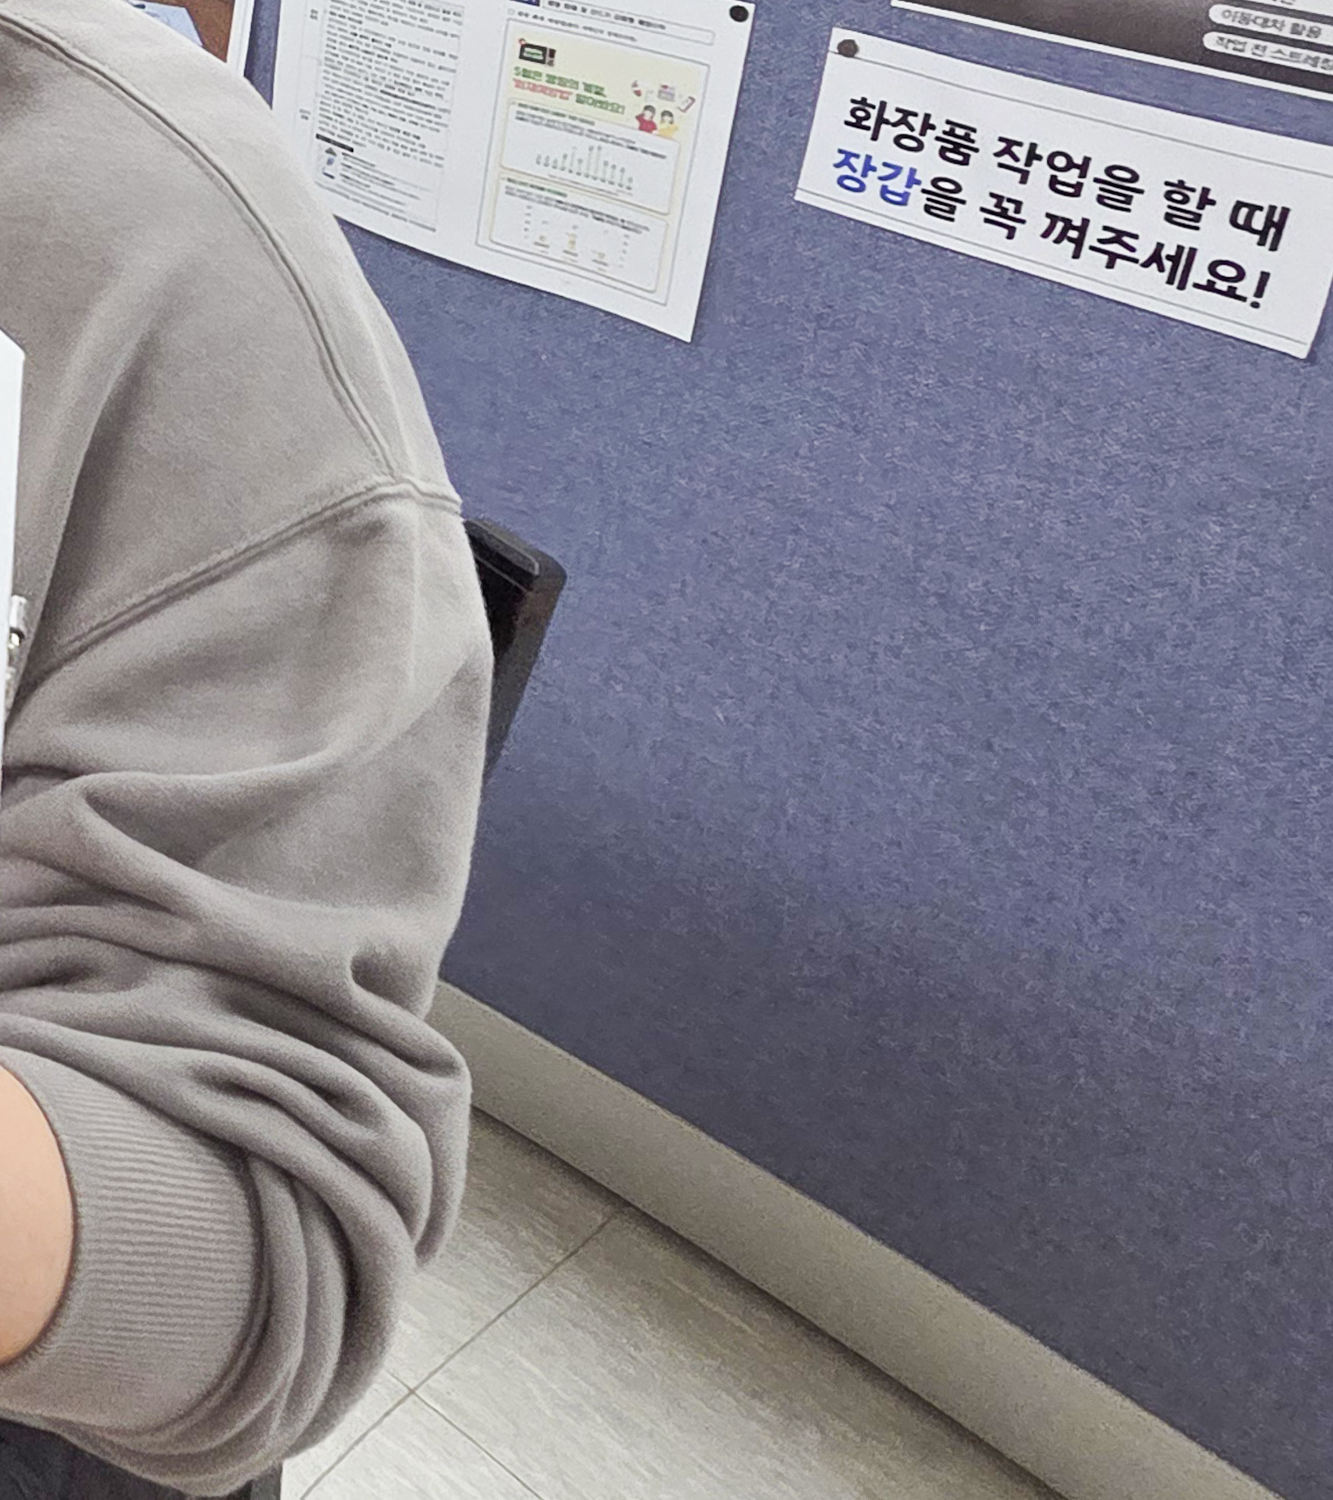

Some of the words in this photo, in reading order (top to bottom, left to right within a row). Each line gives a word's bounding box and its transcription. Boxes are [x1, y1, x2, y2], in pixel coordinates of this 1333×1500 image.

[1216, 35, 1248, 52] 작업
[833, 148, 967, 223] 장갑을
[979, 191, 1027, 241] 꼭
[1040, 210, 1272, 310] 껴주세요!
[843, 96, 980, 167] 화장품
[992, 135, 1145, 214] 작업을
[1162, 179, 1216, 232] 할
[1228, 199, 1291, 253] 때
